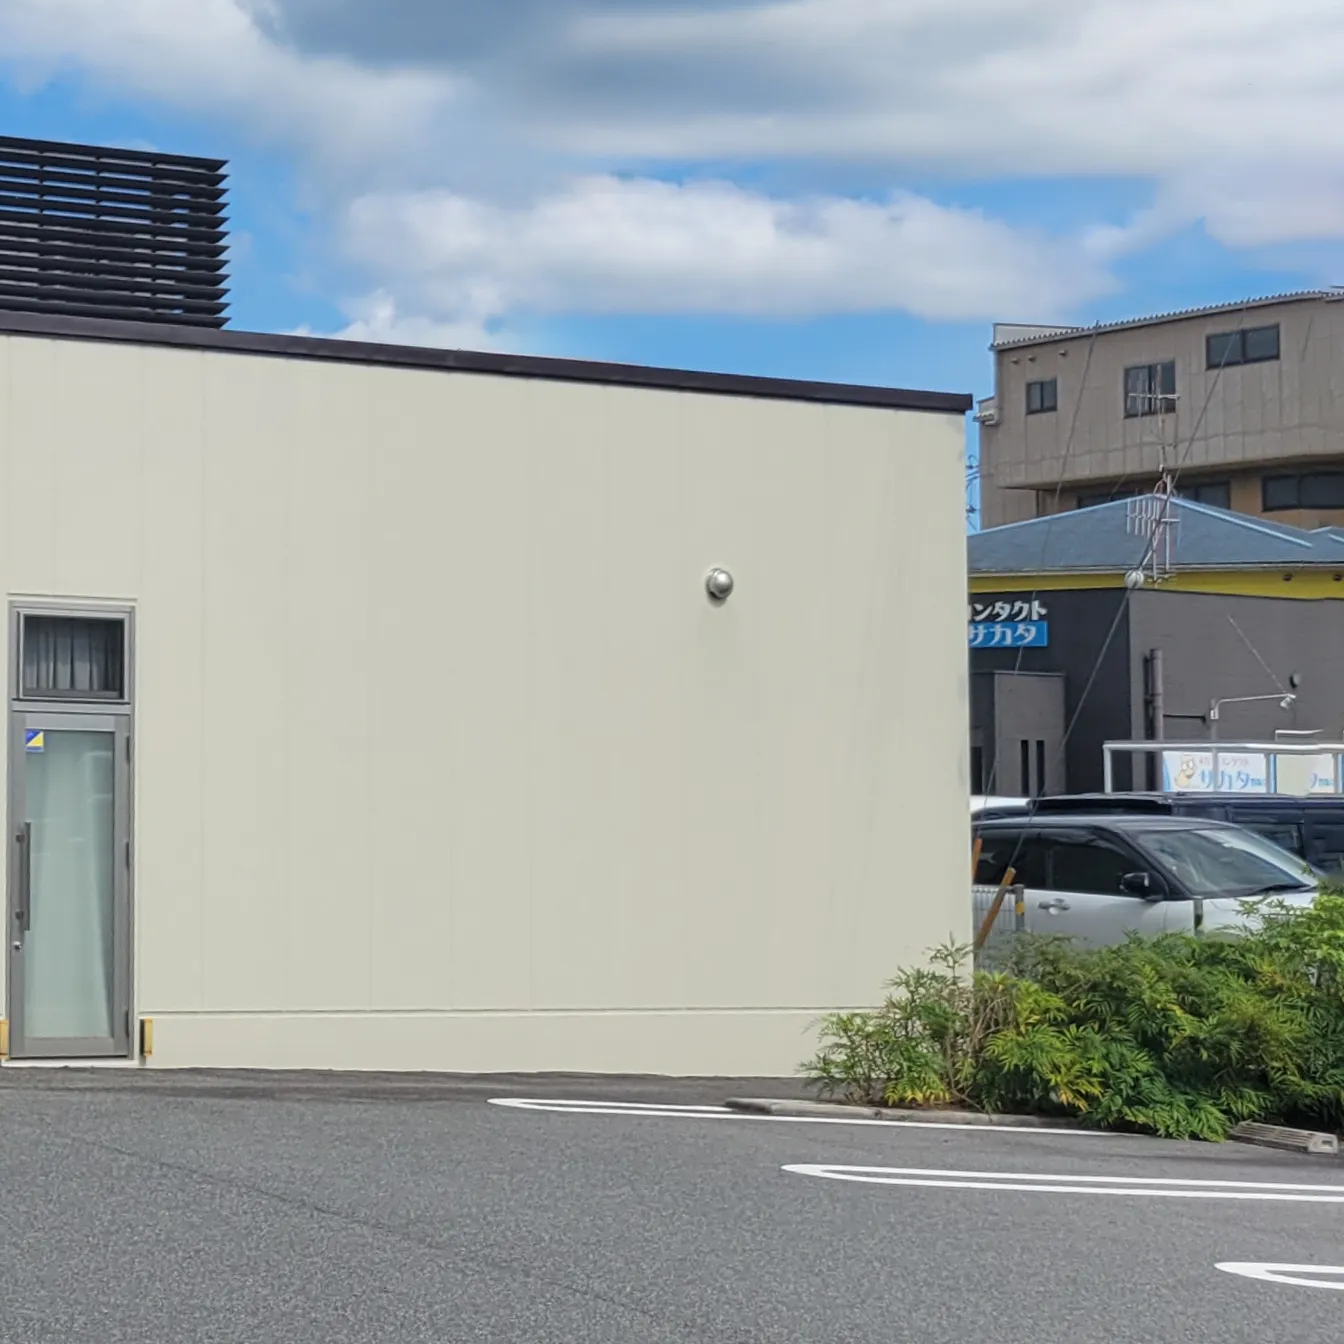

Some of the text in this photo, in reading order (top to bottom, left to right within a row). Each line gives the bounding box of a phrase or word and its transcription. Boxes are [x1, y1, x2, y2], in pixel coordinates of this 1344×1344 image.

[967, 599, 1049, 622] ンタクト
[968, 623, 1037, 646] サカタ
